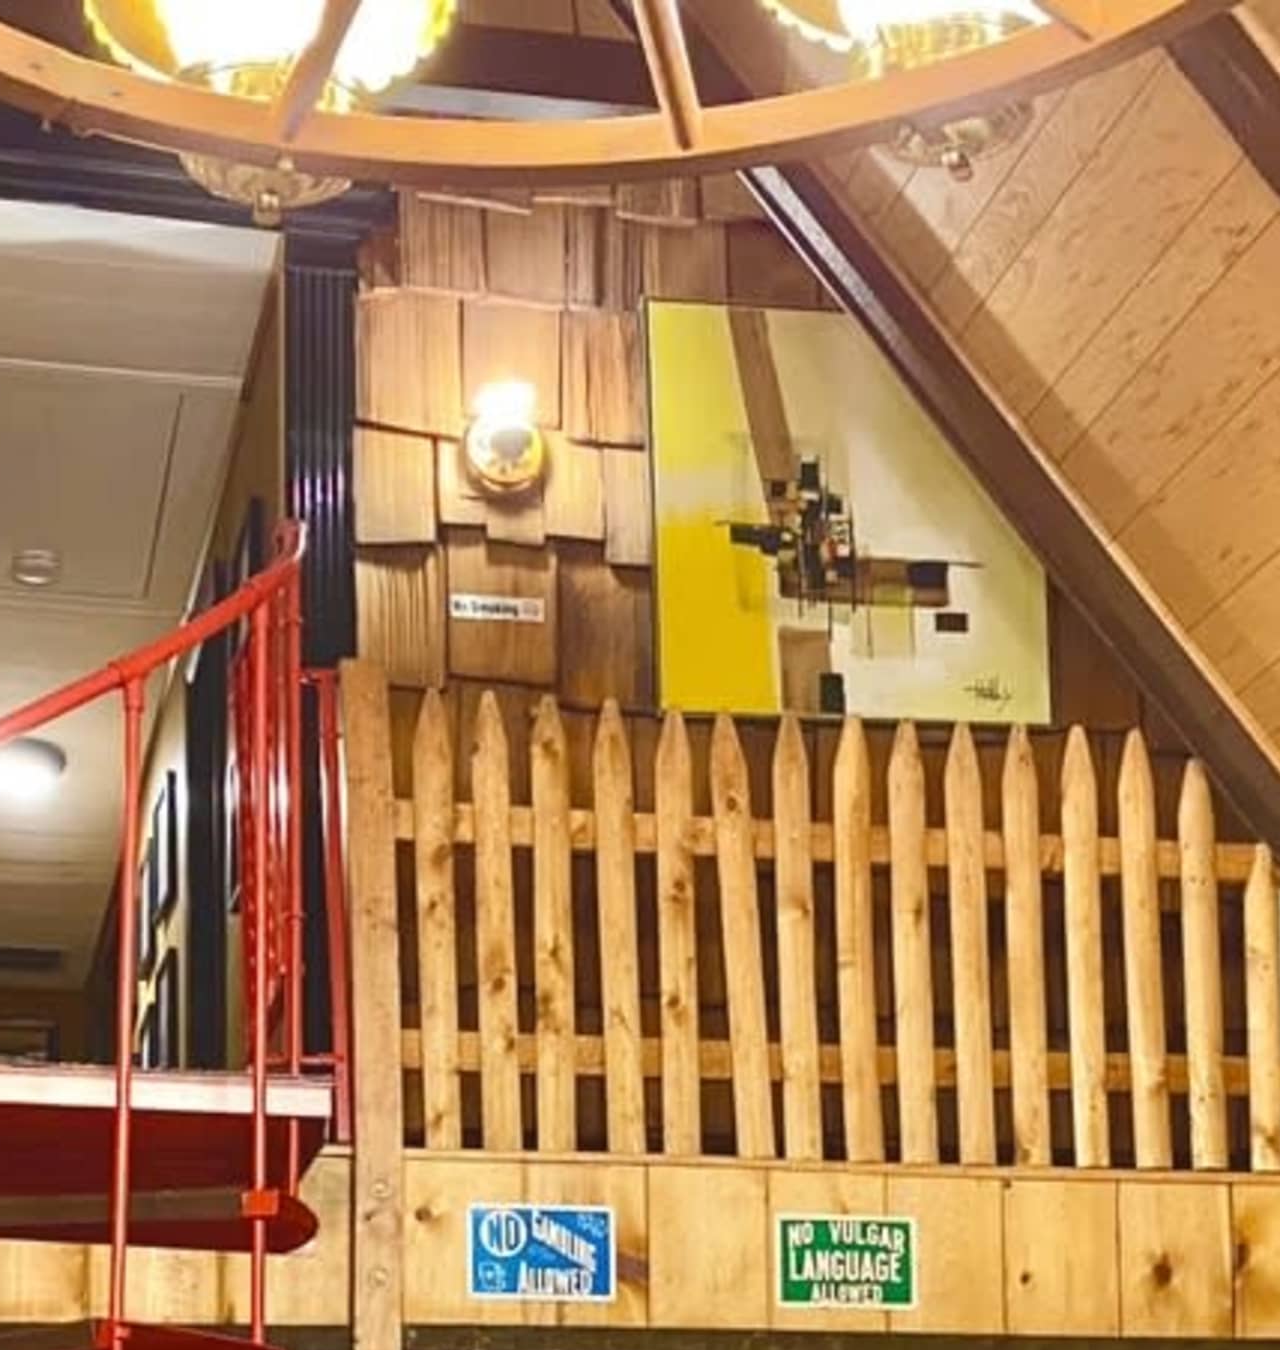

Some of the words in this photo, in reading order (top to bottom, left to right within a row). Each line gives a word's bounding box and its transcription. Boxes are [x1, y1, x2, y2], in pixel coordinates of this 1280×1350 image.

[787, 1222, 815, 1246] NO
[828, 1221, 906, 1256] VULGAR
[518, 1260, 594, 1294] ALLOWED
[788, 1249, 903, 1283] LANGUAGE
[810, 1282, 884, 1303] ALLOWED
